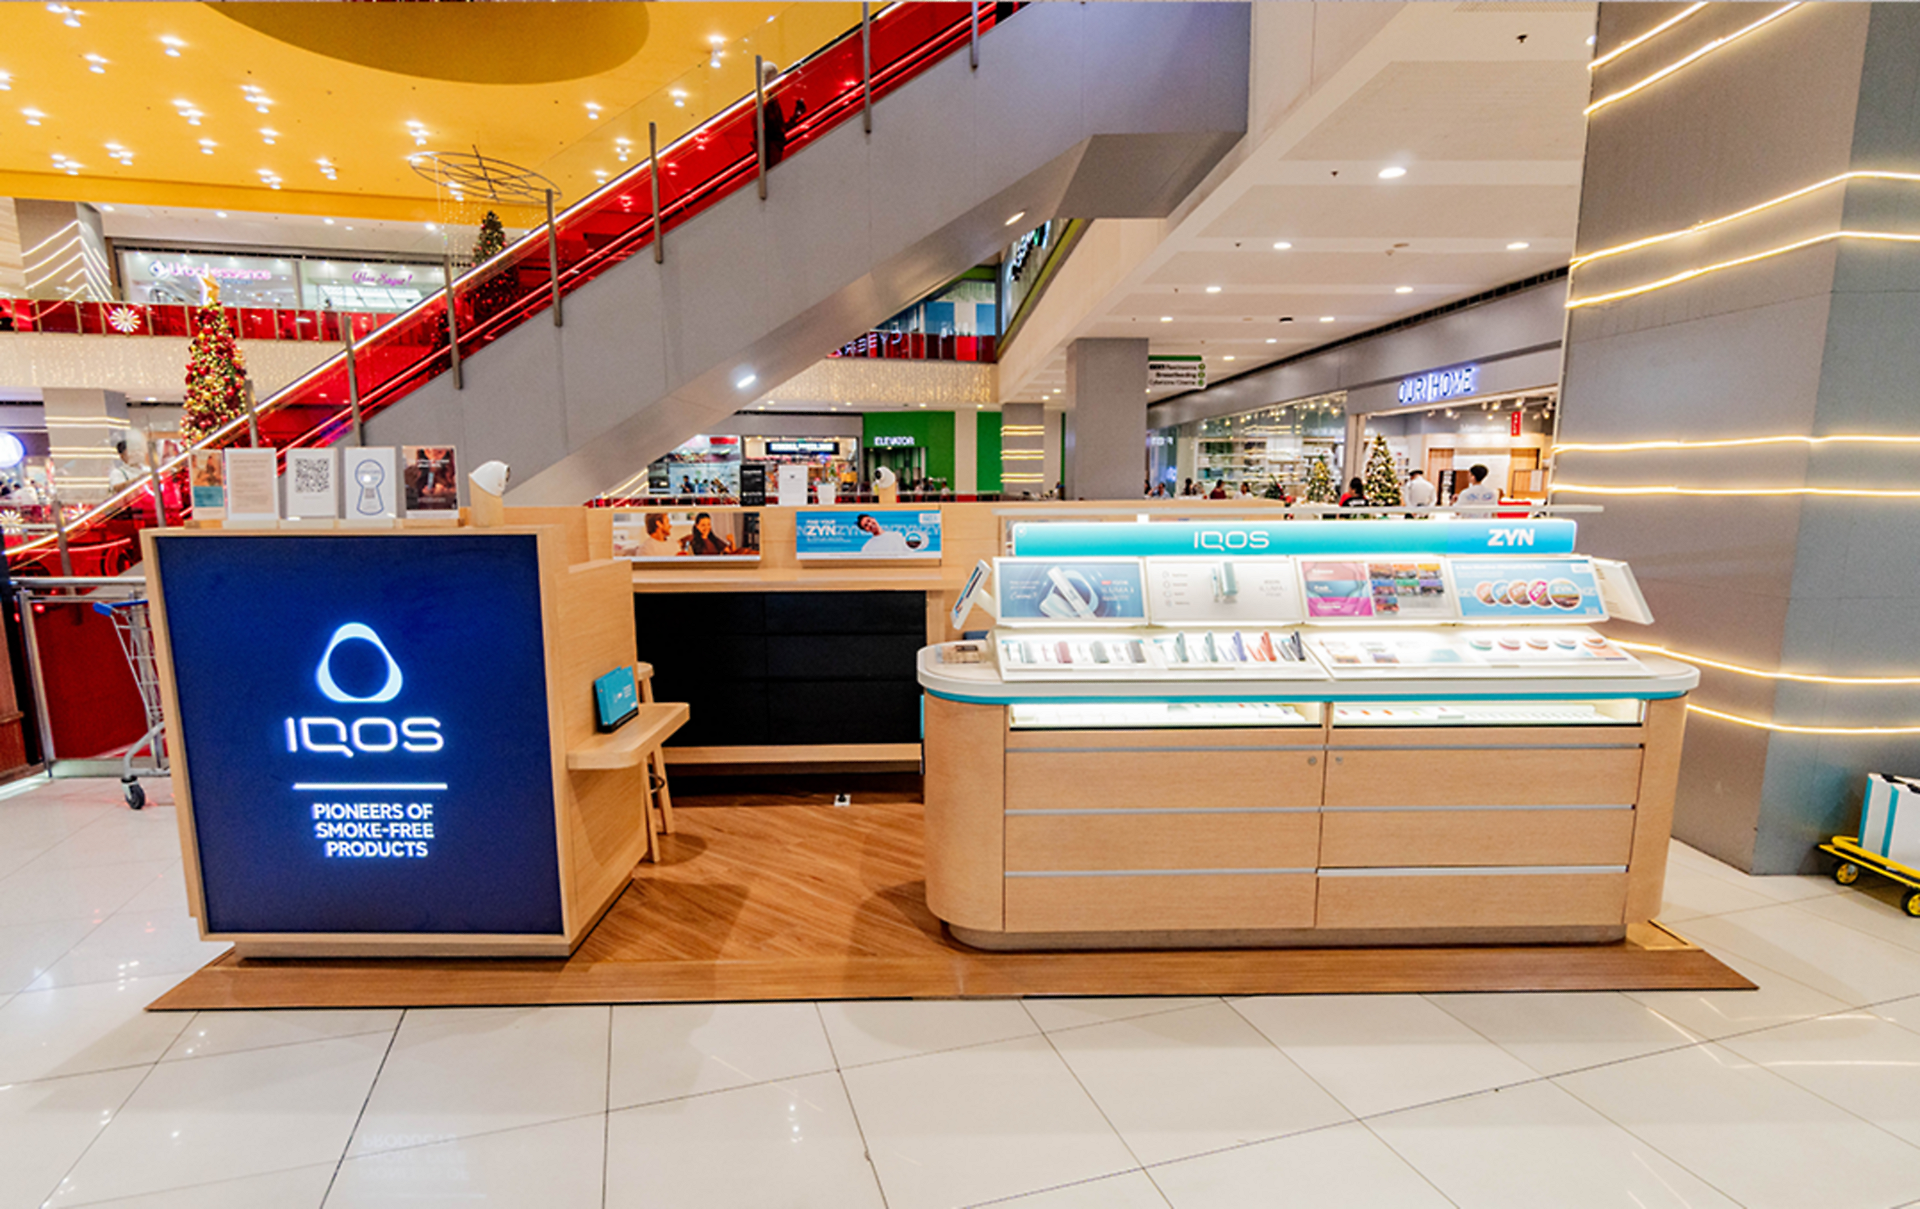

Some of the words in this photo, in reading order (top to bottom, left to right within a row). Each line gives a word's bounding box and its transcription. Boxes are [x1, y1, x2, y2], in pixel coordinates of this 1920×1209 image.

[1398, 377, 1426, 404] OUR
[1427, 367, 1474, 402] HOME
[874, 436, 915, 446] ELEVATOR
[806, 525, 836, 536] ZYN
[1487, 528, 1535, 547] ZYN
[1193, 531, 1270, 552] IQOS
[285, 717, 444, 758] IQOS
[312, 803, 404, 820] PIONEERS
[407, 803, 434, 820] OF
[314, 821, 435, 839] SMOKE-FREE
[325, 841, 429, 858] PRODUCTS
